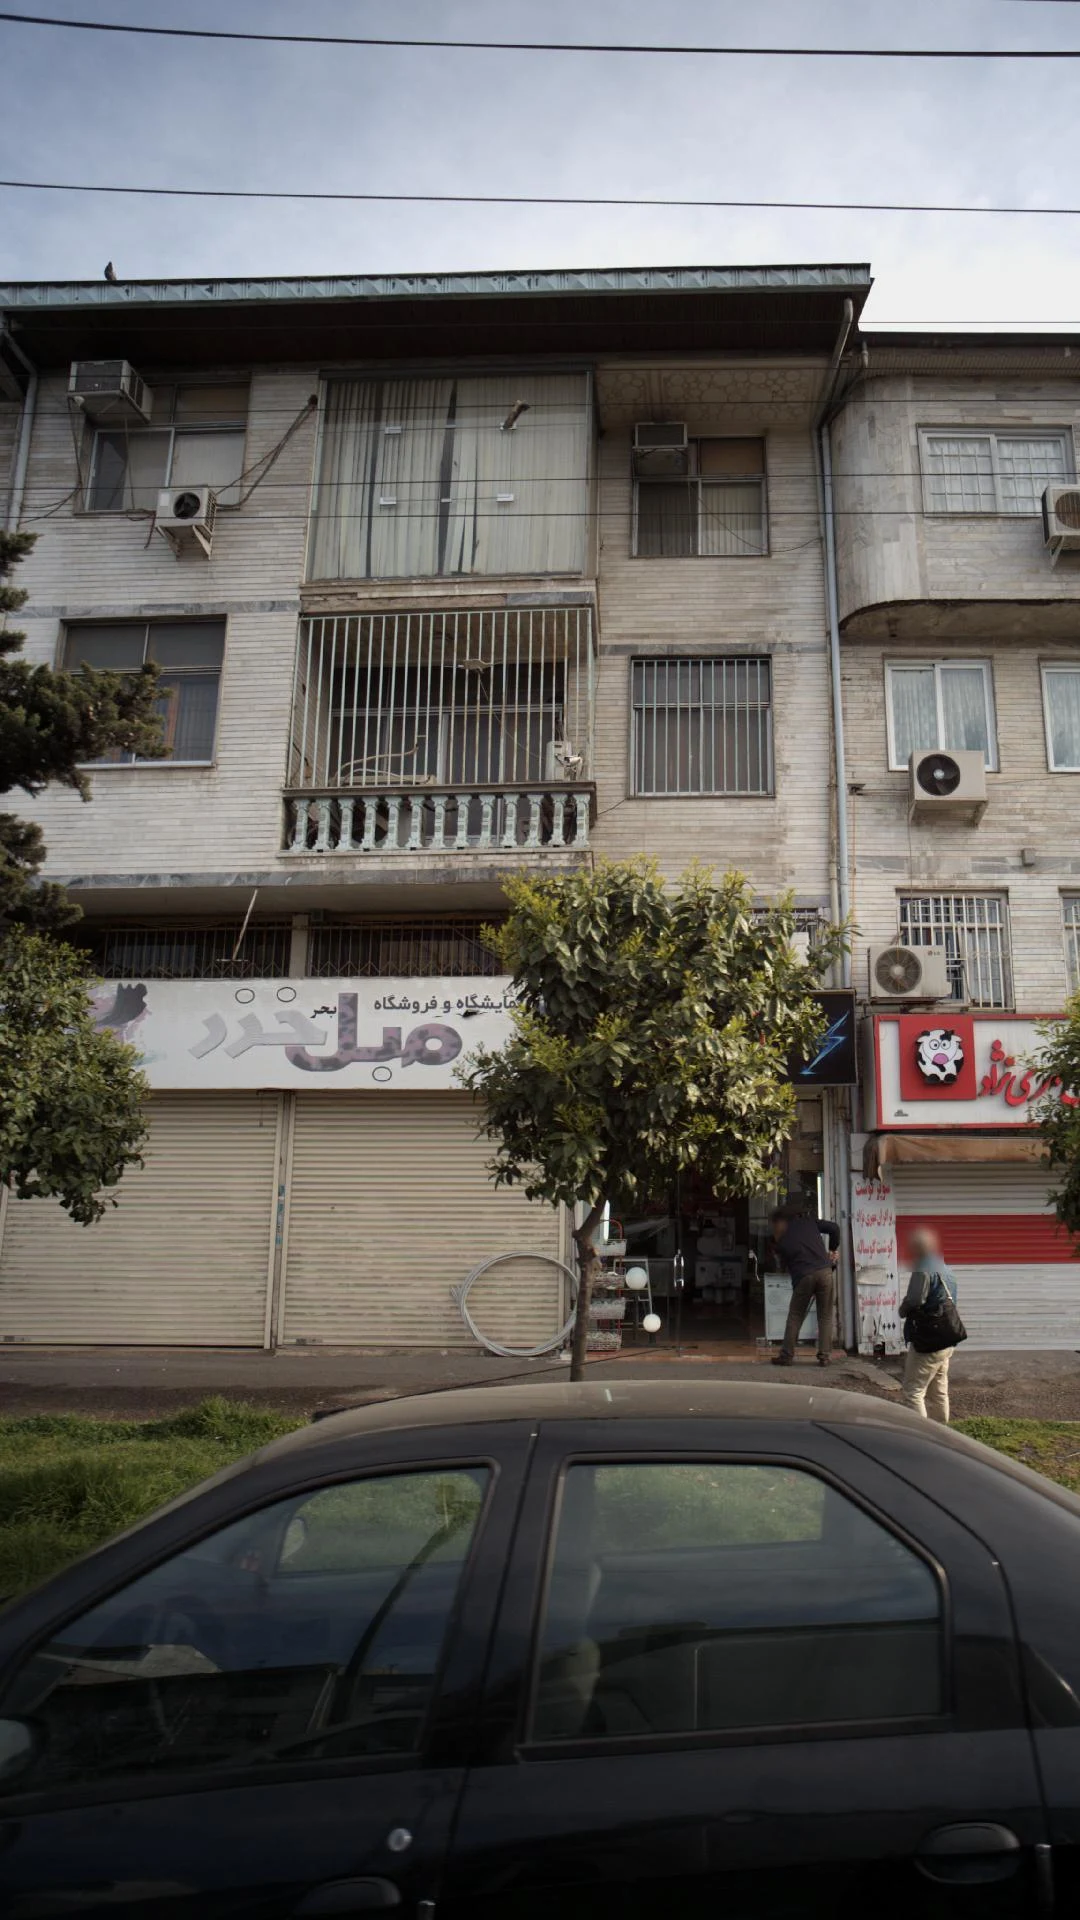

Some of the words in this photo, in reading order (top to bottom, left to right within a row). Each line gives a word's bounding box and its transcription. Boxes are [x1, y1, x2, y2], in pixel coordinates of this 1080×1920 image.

[374, 995, 438, 1014] فروشگاه
[443, 1000, 451, 1013] و
[457, 994, 517, 1014] مایشگاه
[284, 992, 463, 1080] مبل
